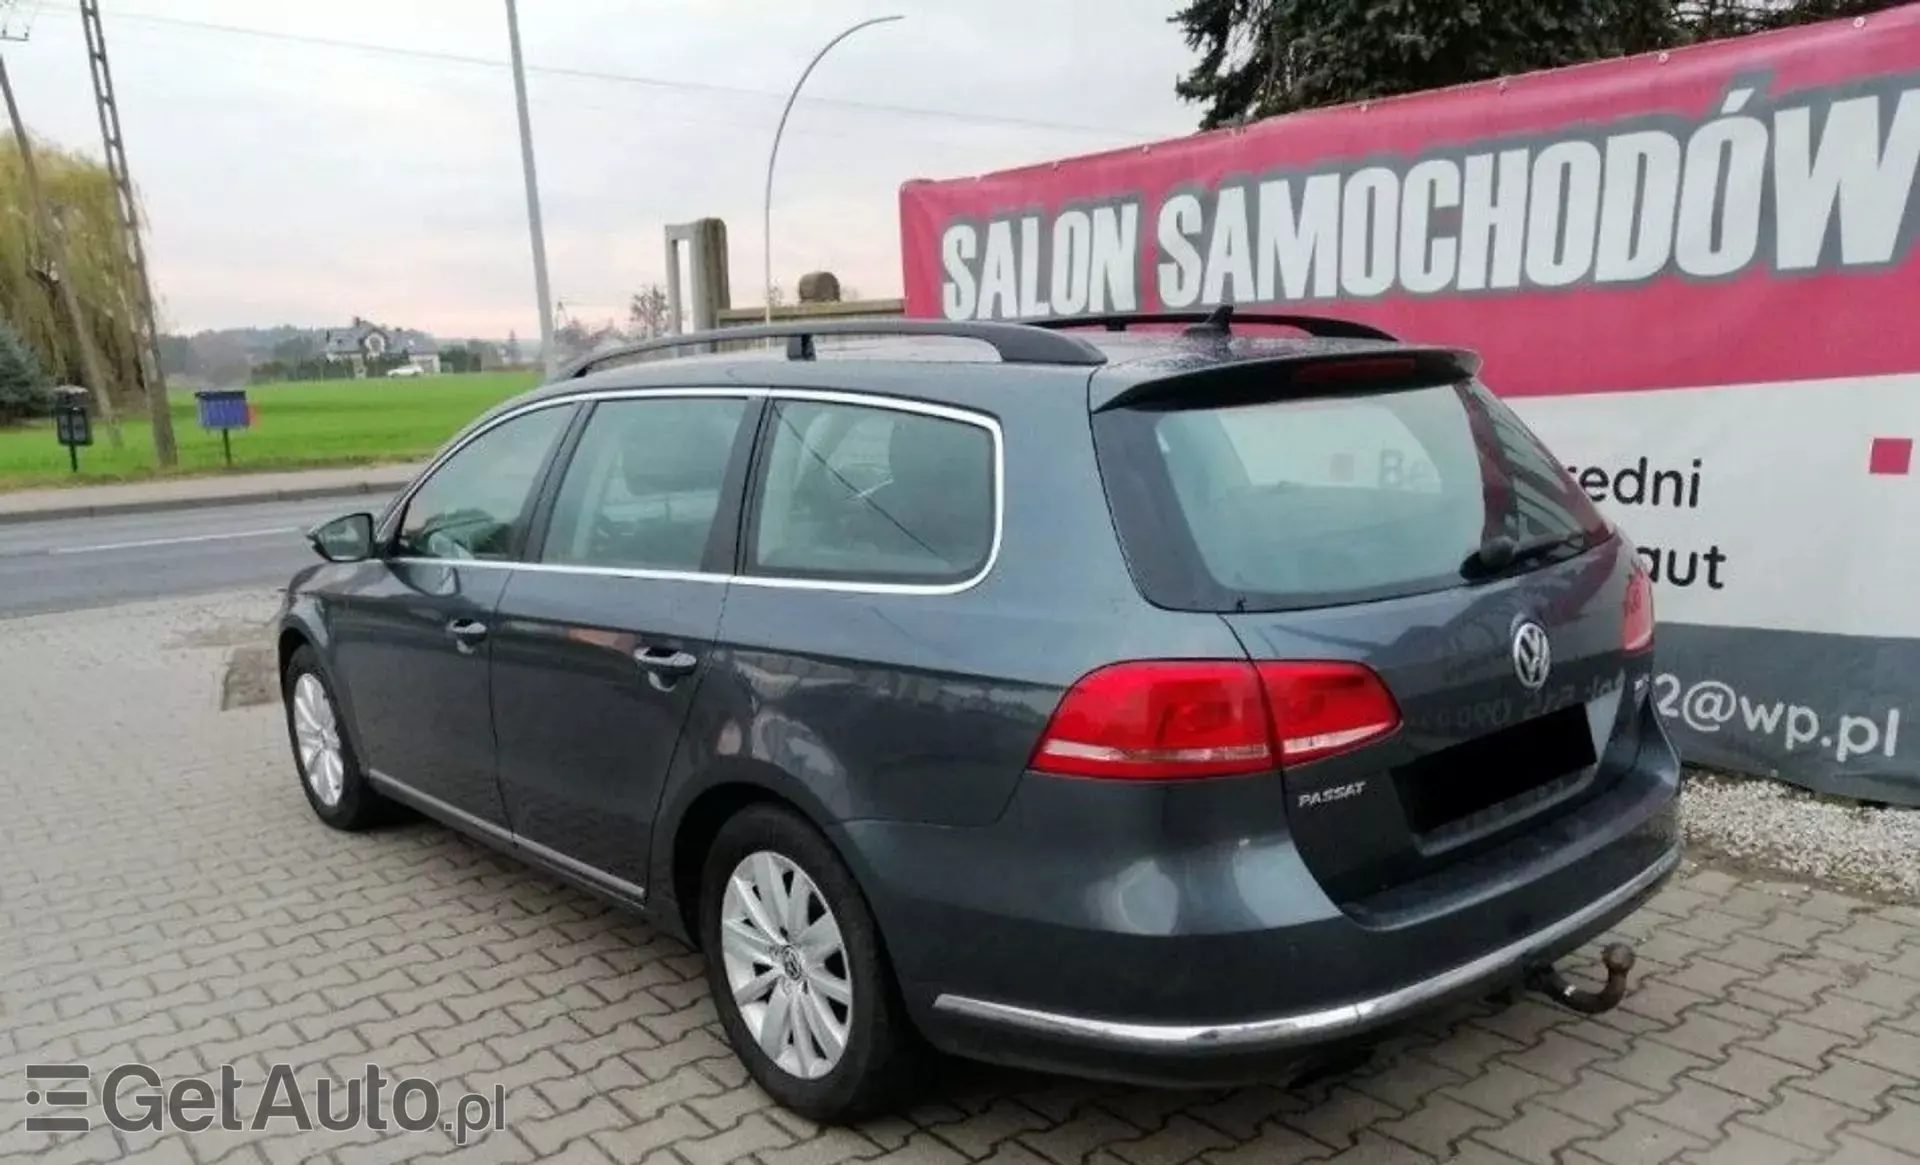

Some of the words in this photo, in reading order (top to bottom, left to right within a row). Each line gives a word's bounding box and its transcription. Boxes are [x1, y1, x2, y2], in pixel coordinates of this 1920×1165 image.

[942, 202, 1139, 321] SALON
[1157, 84, 1920, 308] SAMOCHODÓW
[1298, 780, 1367, 808] PASSAT
